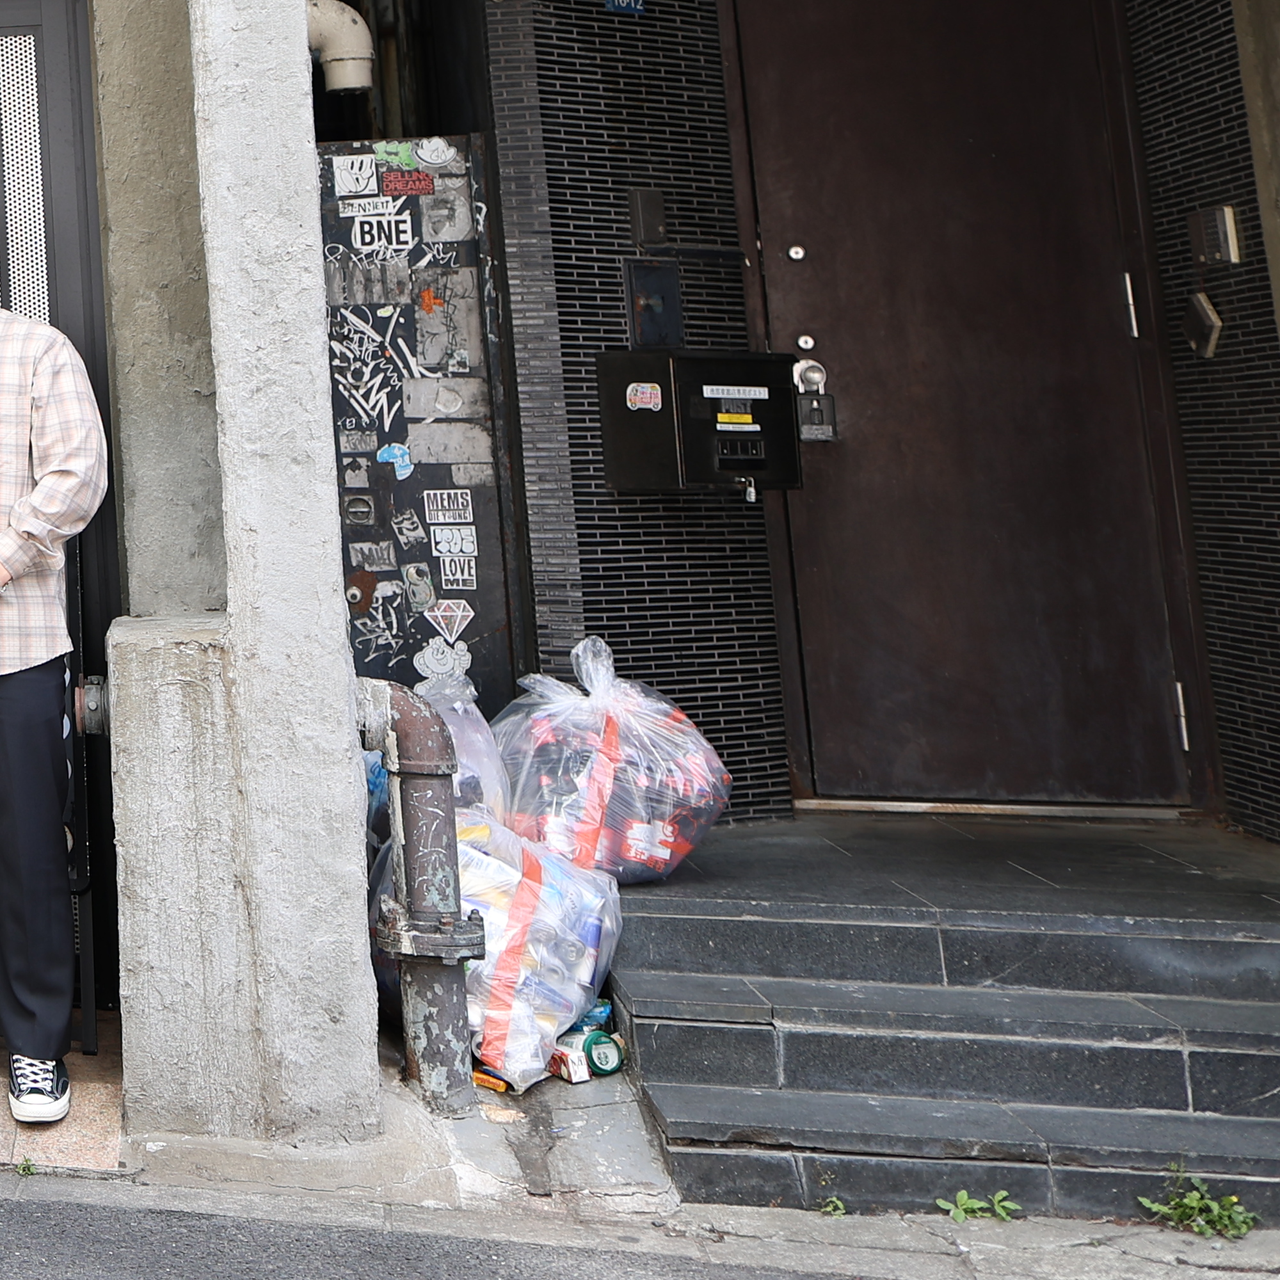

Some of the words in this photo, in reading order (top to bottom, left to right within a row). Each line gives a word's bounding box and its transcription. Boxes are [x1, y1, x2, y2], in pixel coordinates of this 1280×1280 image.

[382, 172, 433, 181] SELLING
[382, 181, 434, 190] DREAMS
[359, 219, 409, 247] BNE
[425, 492, 470, 510] MEMS
[428, 511, 440, 522] DIE
[442, 559, 475, 577] LOVE
[444, 578, 475, 588] ME
